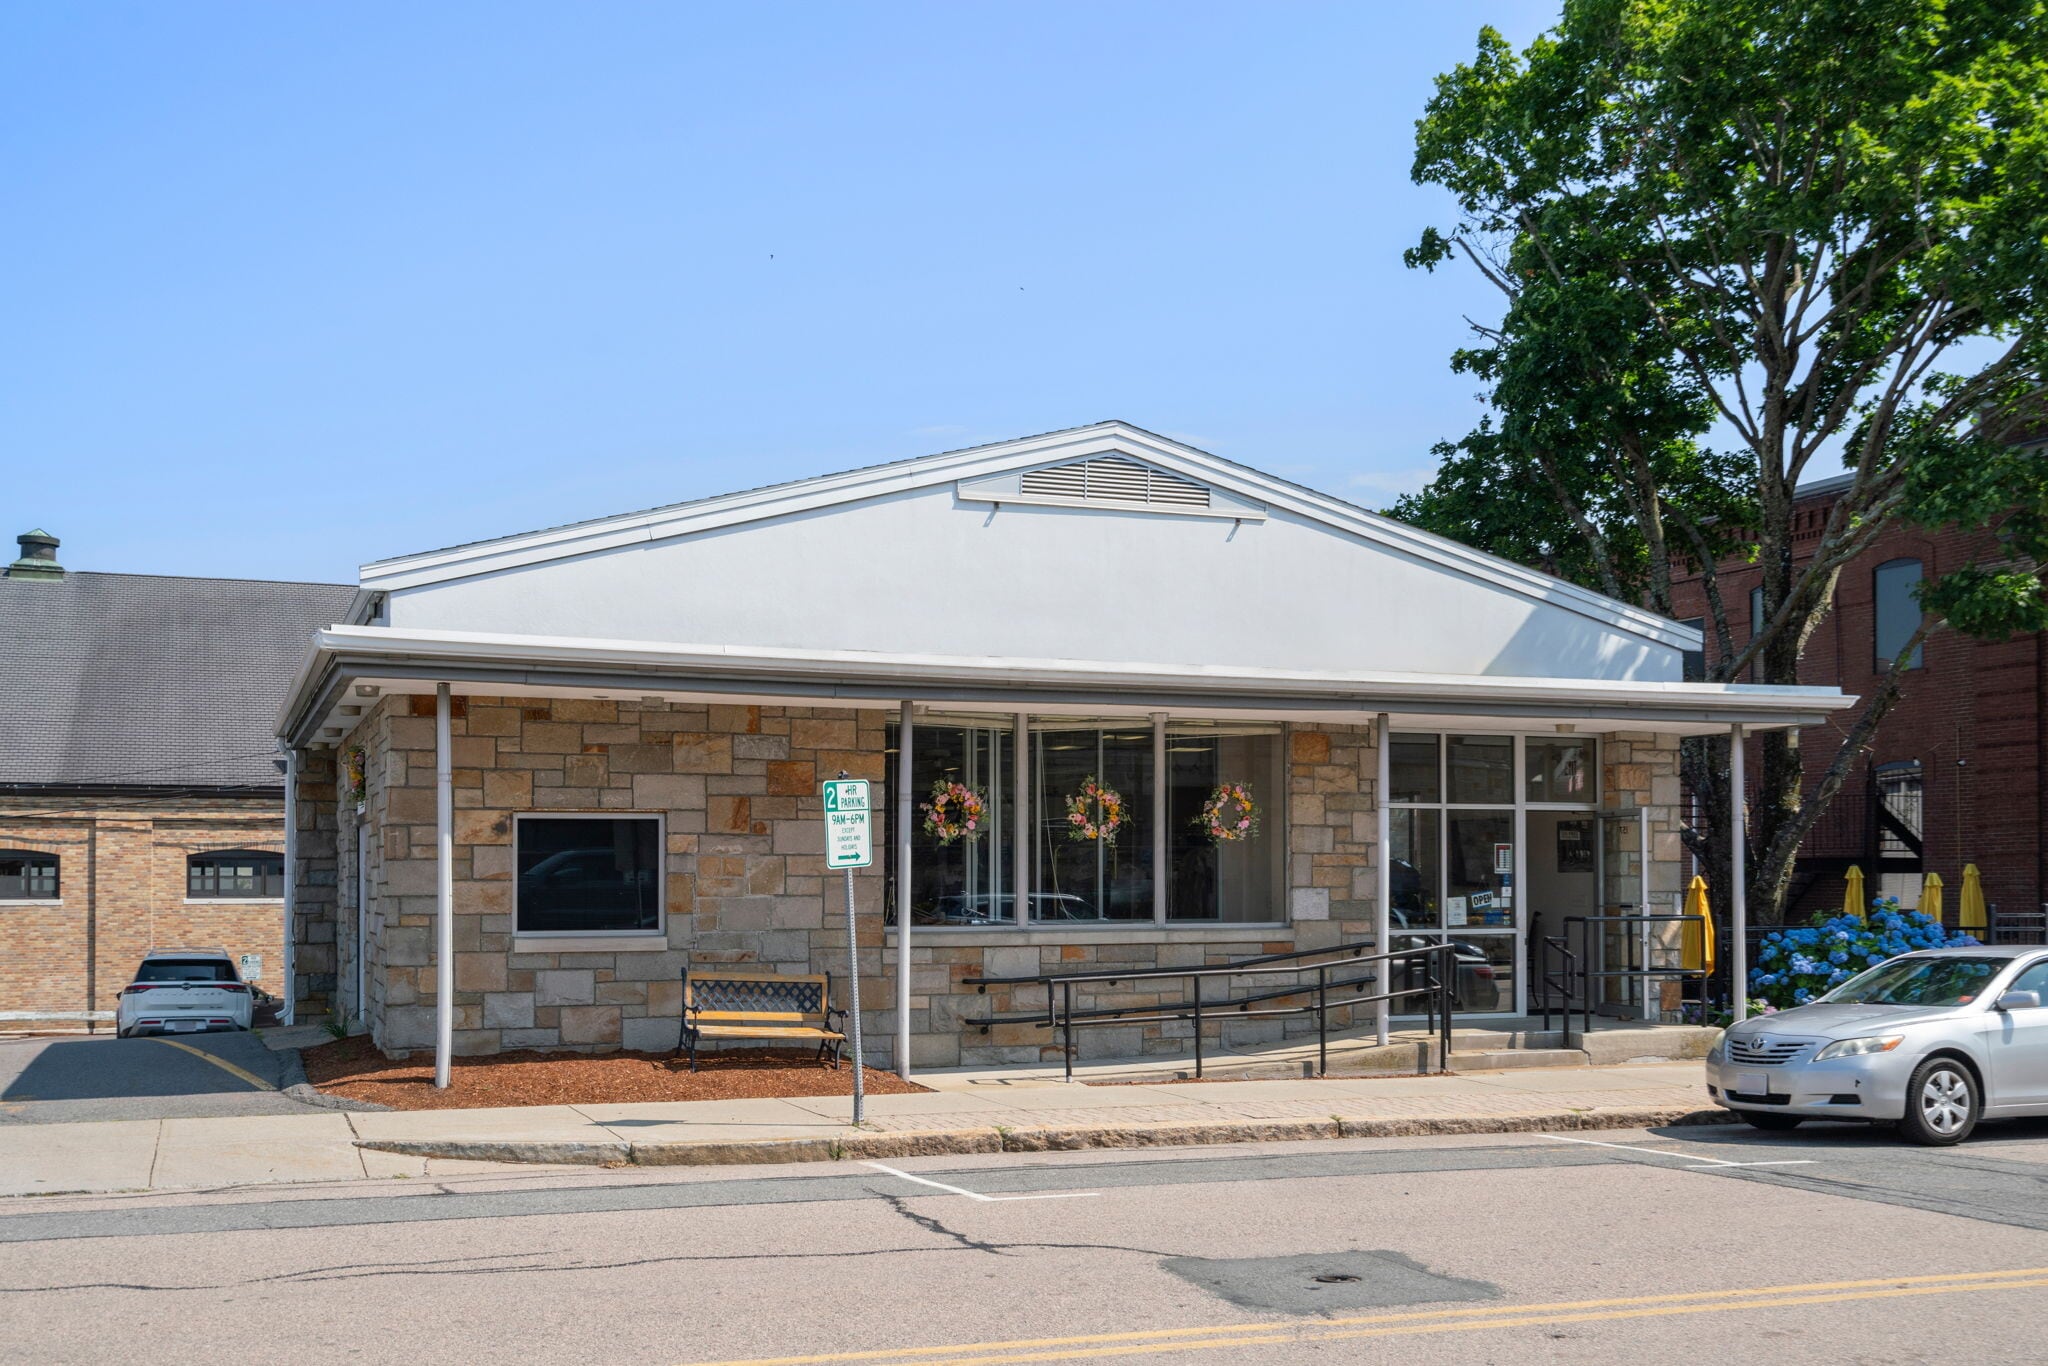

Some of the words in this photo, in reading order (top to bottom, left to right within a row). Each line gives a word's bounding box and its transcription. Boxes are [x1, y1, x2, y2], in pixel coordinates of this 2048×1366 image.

[847, 785, 857, 795] HR
[827, 787, 836, 808] 2
[841, 797, 865, 808] PARKING
[832, 814, 864, 825] 9AM-6PM
[1473, 893, 1492, 906] OPEN
